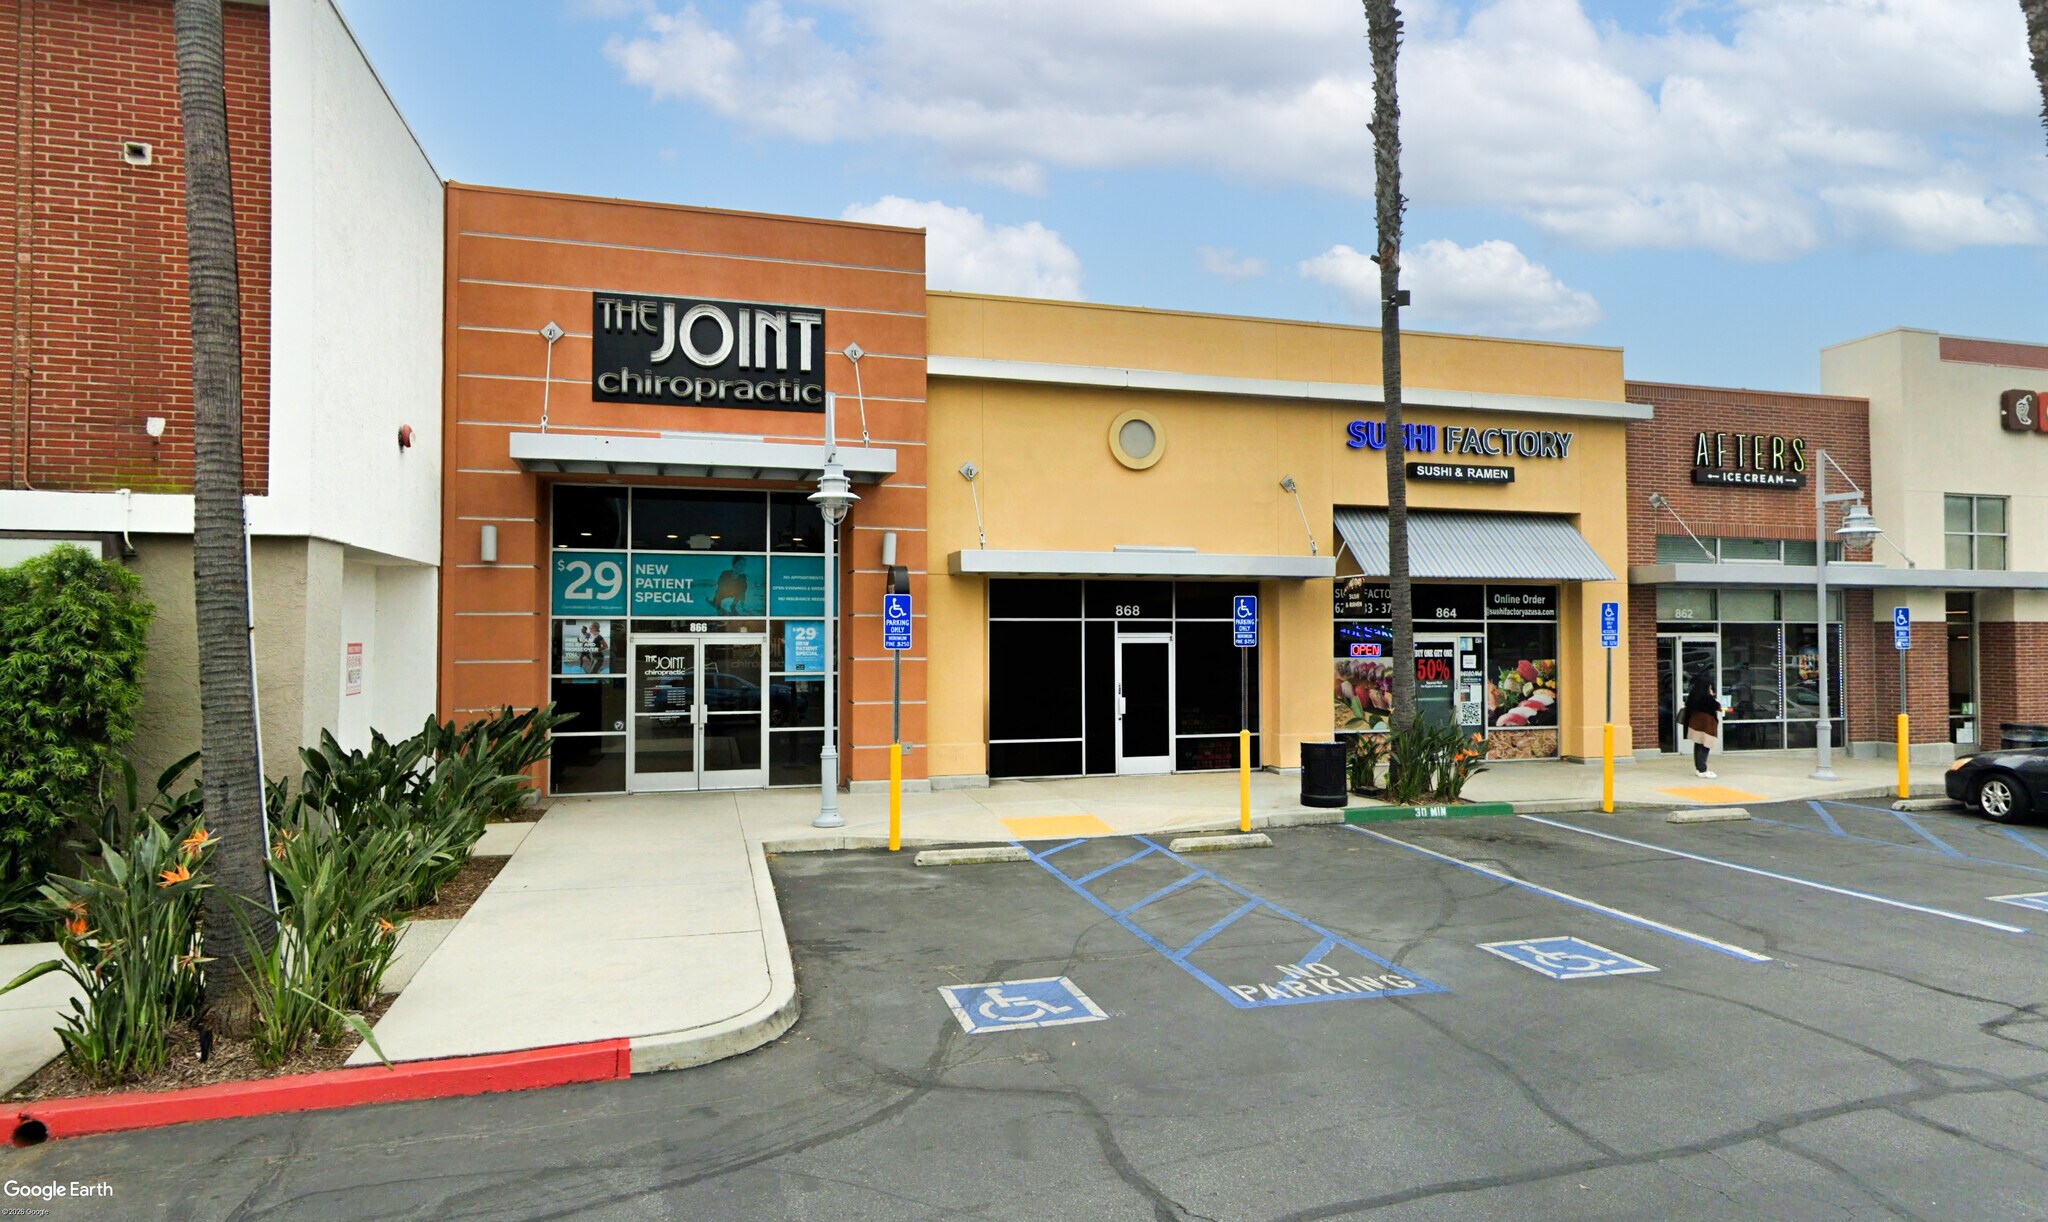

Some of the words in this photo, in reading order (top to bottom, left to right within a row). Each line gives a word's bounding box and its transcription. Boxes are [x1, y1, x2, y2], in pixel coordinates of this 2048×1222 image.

[597, 298, 657, 335] THE
[650, 302, 822, 373] JOINT
[598, 367, 822, 405] chiropractic
[1445, 426, 1572, 459] FACTORY
[1695, 432, 1804, 472] AFTERS
[1416, 466, 1452, 477] SUSHI
[1454, 466, 1463, 477] &
[1467, 468, 1508, 479] RAMEN
[1723, 472, 1741, 482] ICE
[1744, 473, 1783, 484] CREAM
[636, 564, 668, 575] NEW
[636, 578, 693, 589] PATIENT
[635, 592, 694, 603] SPECIAL
[1494, 594, 1520, 604] Online
[1522, 594, 1546, 604] Order
[1116, 605, 1140, 616] 868
[1436, 608, 1456, 618] 864
[1675, 609, 1693, 618] 862
[690, 622, 707, 632] 866
[1352, 645, 1379, 655] OPEN
[1418, 659, 1450, 680] 50%
[1415, 808, 1427, 817] 30
[1430, 806, 1446, 817] MIN
[1274, 962, 1340, 978] NO
[1228, 974, 1416, 1002] PARKING
